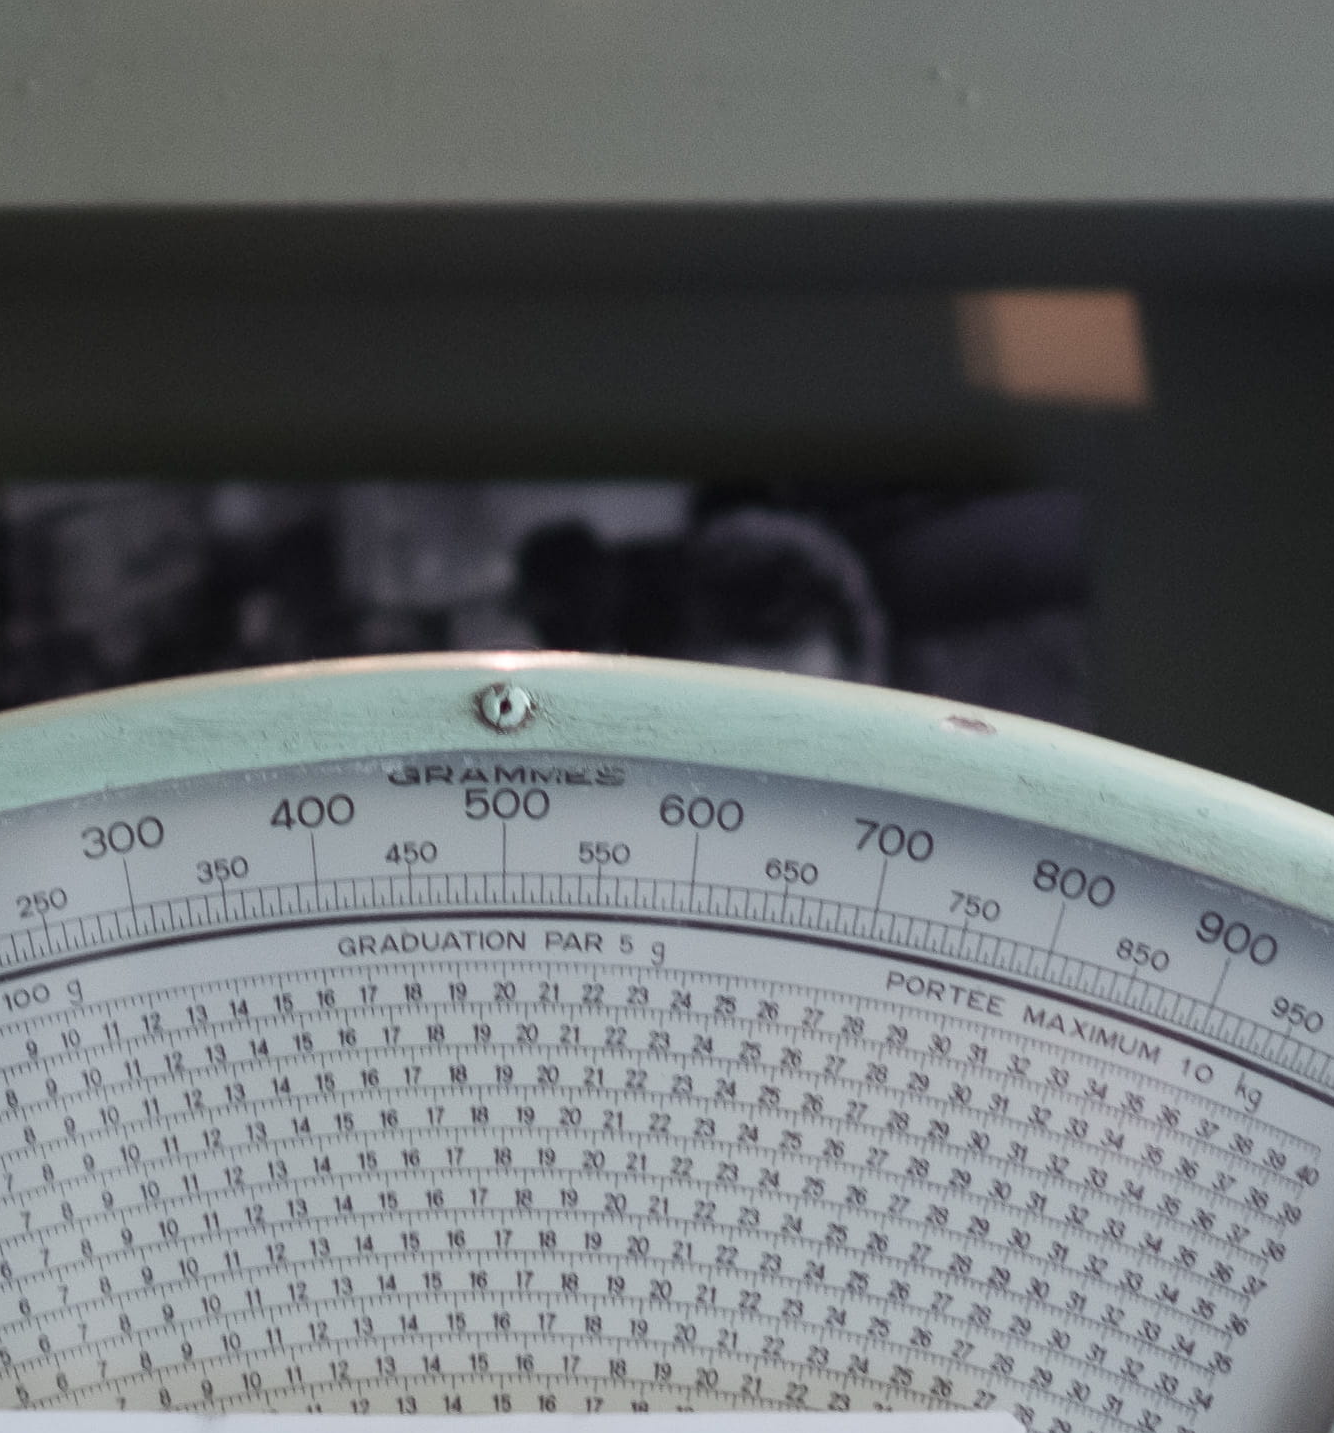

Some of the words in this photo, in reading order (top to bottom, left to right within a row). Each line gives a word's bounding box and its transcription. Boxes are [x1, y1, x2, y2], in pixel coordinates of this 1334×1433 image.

[386, 763, 626, 787] GRAMMES
[80, 814, 165, 860] 300
[269, 792, 356, 831] 400
[463, 787, 551, 820] 500
[657, 795, 745, 834] 600
[853, 816, 936, 864] 700
[1031, 860, 1117, 909] 800
[1194, 910, 1280, 967] 900
[14, 887, 68, 918] 250
[195, 855, 250, 884] 350
[384, 840, 438, 866] 450
[577, 841, 631, 866] 550
[764, 857, 820, 887] 650
[947, 889, 1001, 922] 750
[1115, 937, 1171, 972] 850
[1271, 996, 1324, 1035] 950
[336, 930, 527, 958] GRADUATION
[544, 929, 604, 954] PAR
[618, 933, 635, 954] 5
[649, 938, 668, 965] g
[1, 982, 51, 1011] 100
[66, 978, 84, 1005] g
[25, 1038, 39, 1059] 9
[60, 1028, 82, 1050] 10
[102, 1020, 121, 1042] 11
[141, 1011, 163, 1034] 12
[186, 1004, 209, 1027] 13
[229, 998, 249, 1019] 14
[272, 992, 294, 1014] 15
[316, 988, 336, 1009] 16
[360, 983, 378, 1004] 17
[403, 981, 423, 1003] 18
[448, 981, 467, 1003] 19
[493, 980, 517, 1004] 20
[538, 980, 560, 1004] 21
[581, 982, 605, 1007] 22
[626, 984, 650, 1007] 23
[670, 989, 693, 1014] 24
[713, 993, 738, 1017] 25
[757, 999, 780, 1022] 26
[885, 969, 1006, 1018] PORTEE
[1022, 1007, 1161, 1066] MAXIMUM
[1181, 1057, 1215, 1086] 10
[1233, 1072, 1264, 1114] kg
